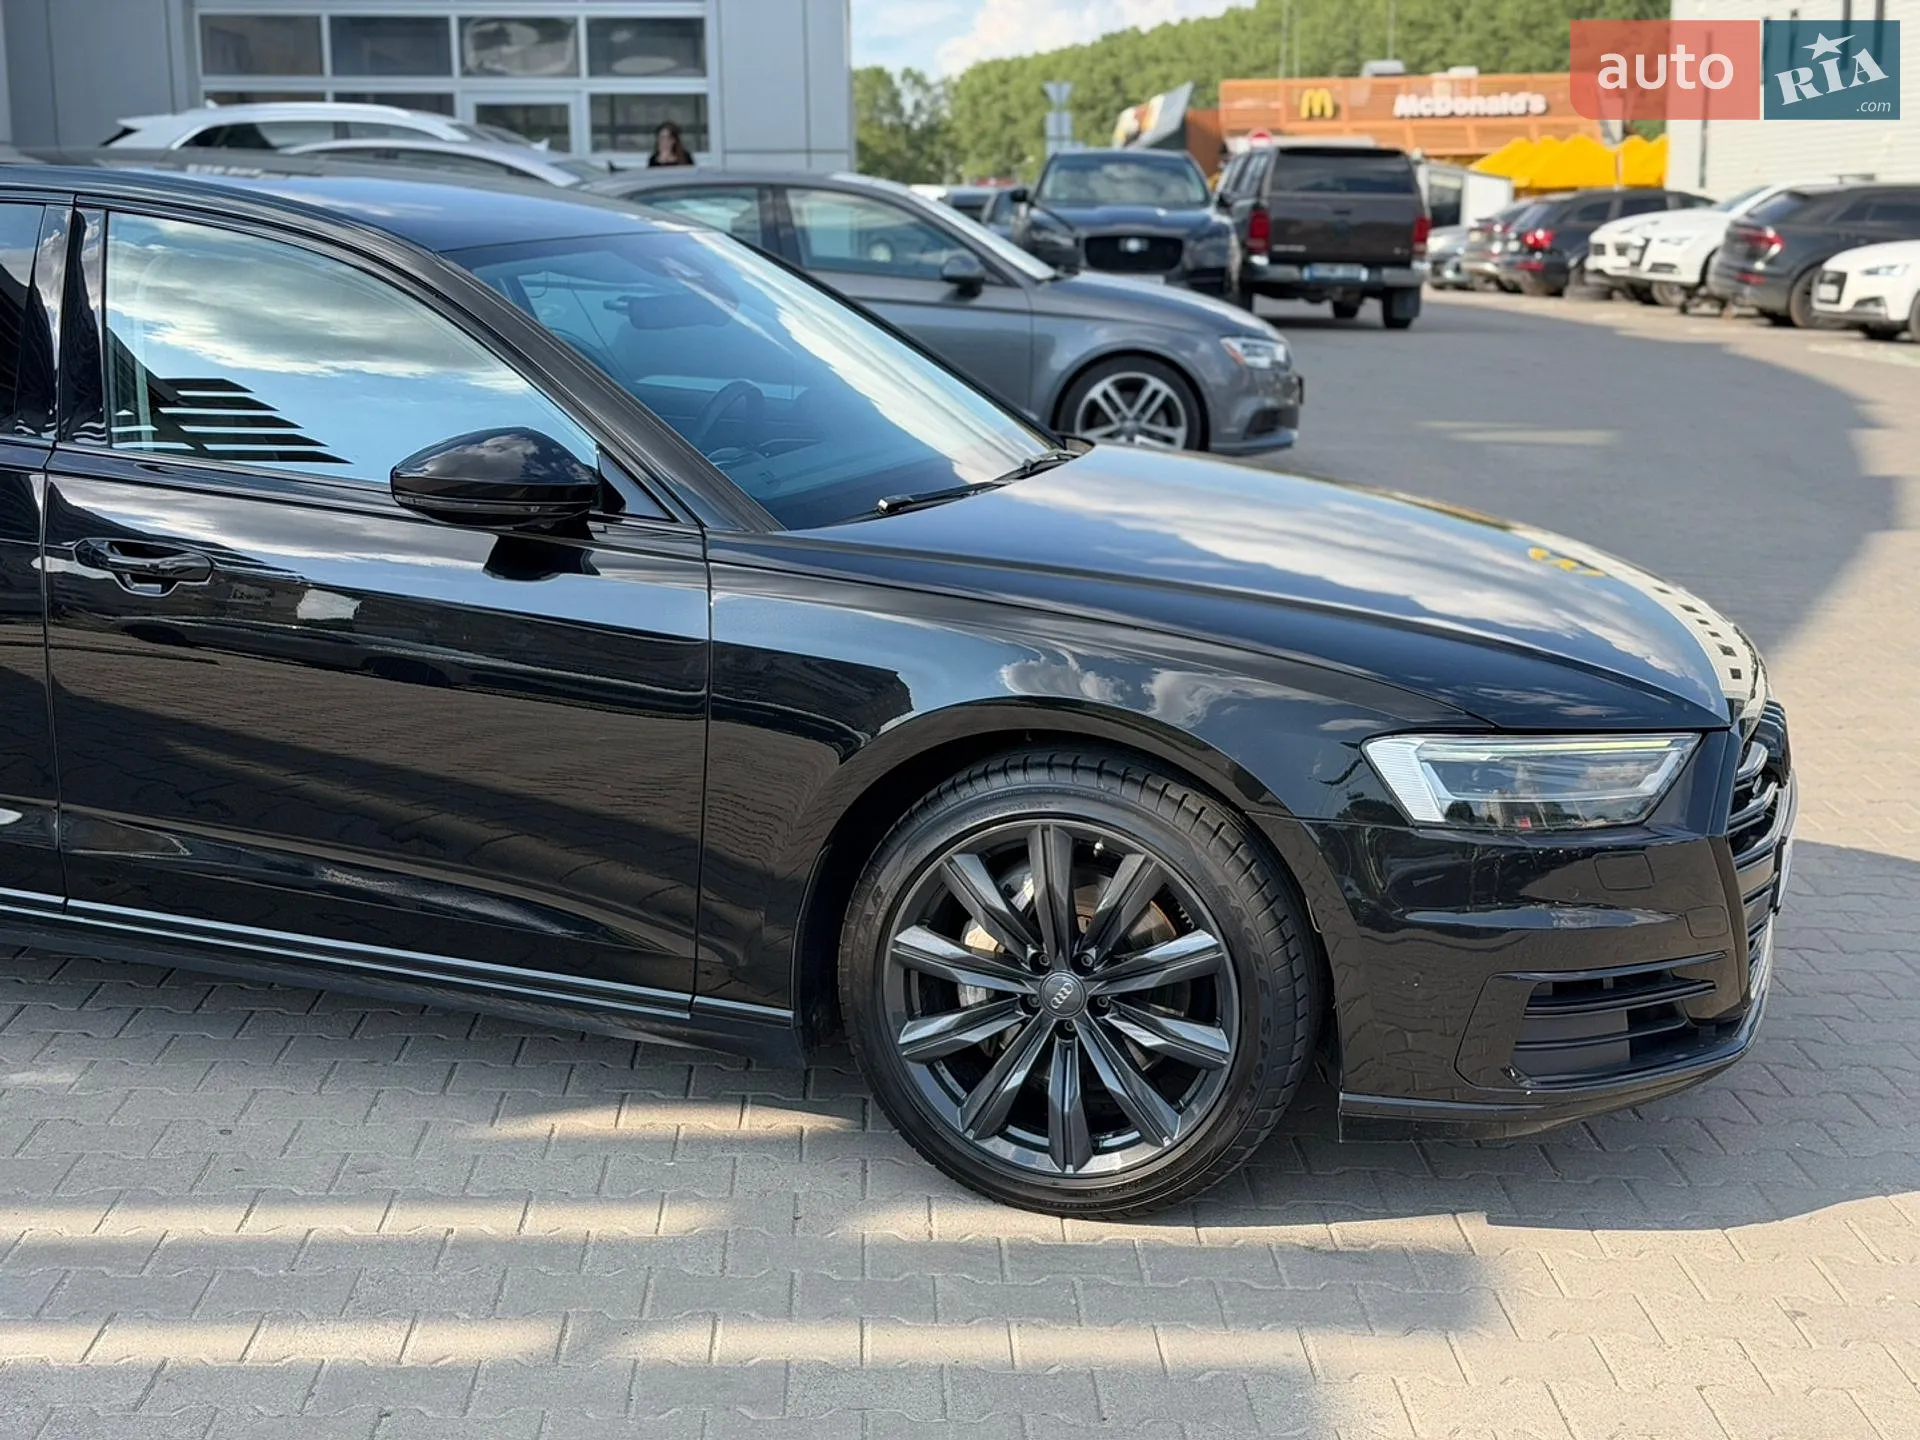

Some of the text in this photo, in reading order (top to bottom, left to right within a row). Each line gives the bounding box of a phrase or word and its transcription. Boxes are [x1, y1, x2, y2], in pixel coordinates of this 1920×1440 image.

[1393, 92, 1548, 117] McDonald's
[1217, 884, 1272, 1119] EAGLE SPORT
